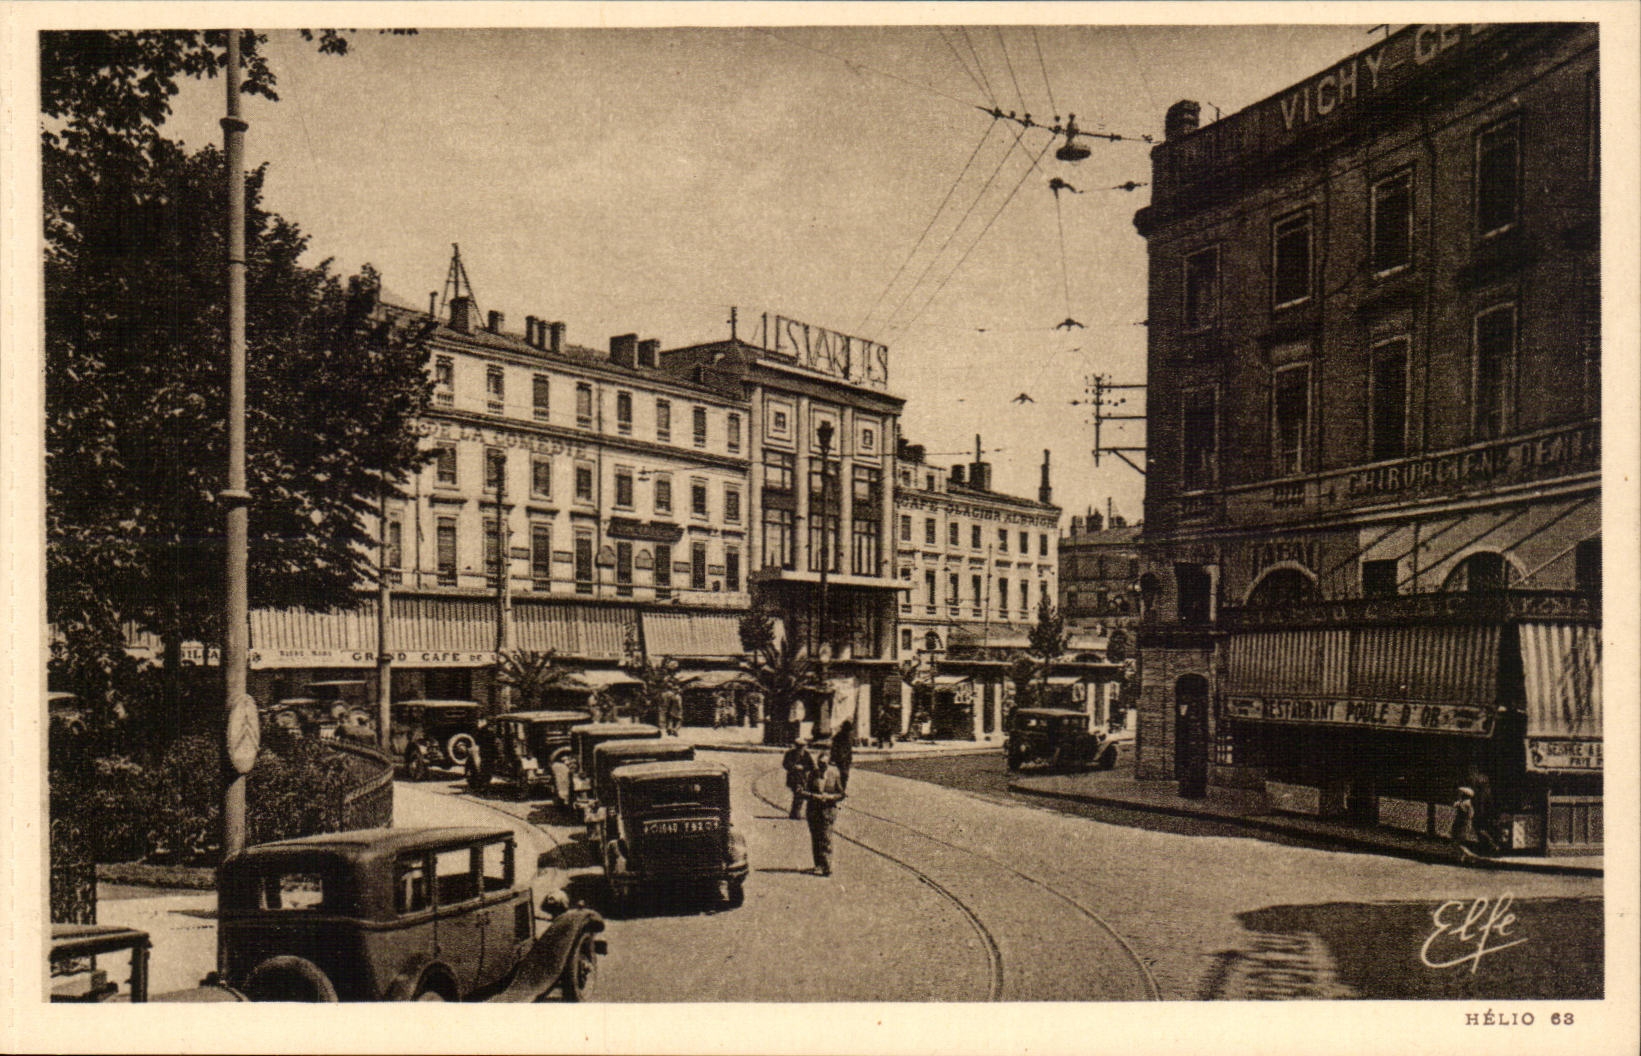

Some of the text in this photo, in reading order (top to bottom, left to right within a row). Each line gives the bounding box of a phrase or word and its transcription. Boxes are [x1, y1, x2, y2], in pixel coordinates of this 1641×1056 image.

[1280, 47, 1385, 130] VICHY
[352, 652, 407, 662] GRND
[421, 652, 460, 662] CAFE
[1346, 702, 1389, 724] POULE
